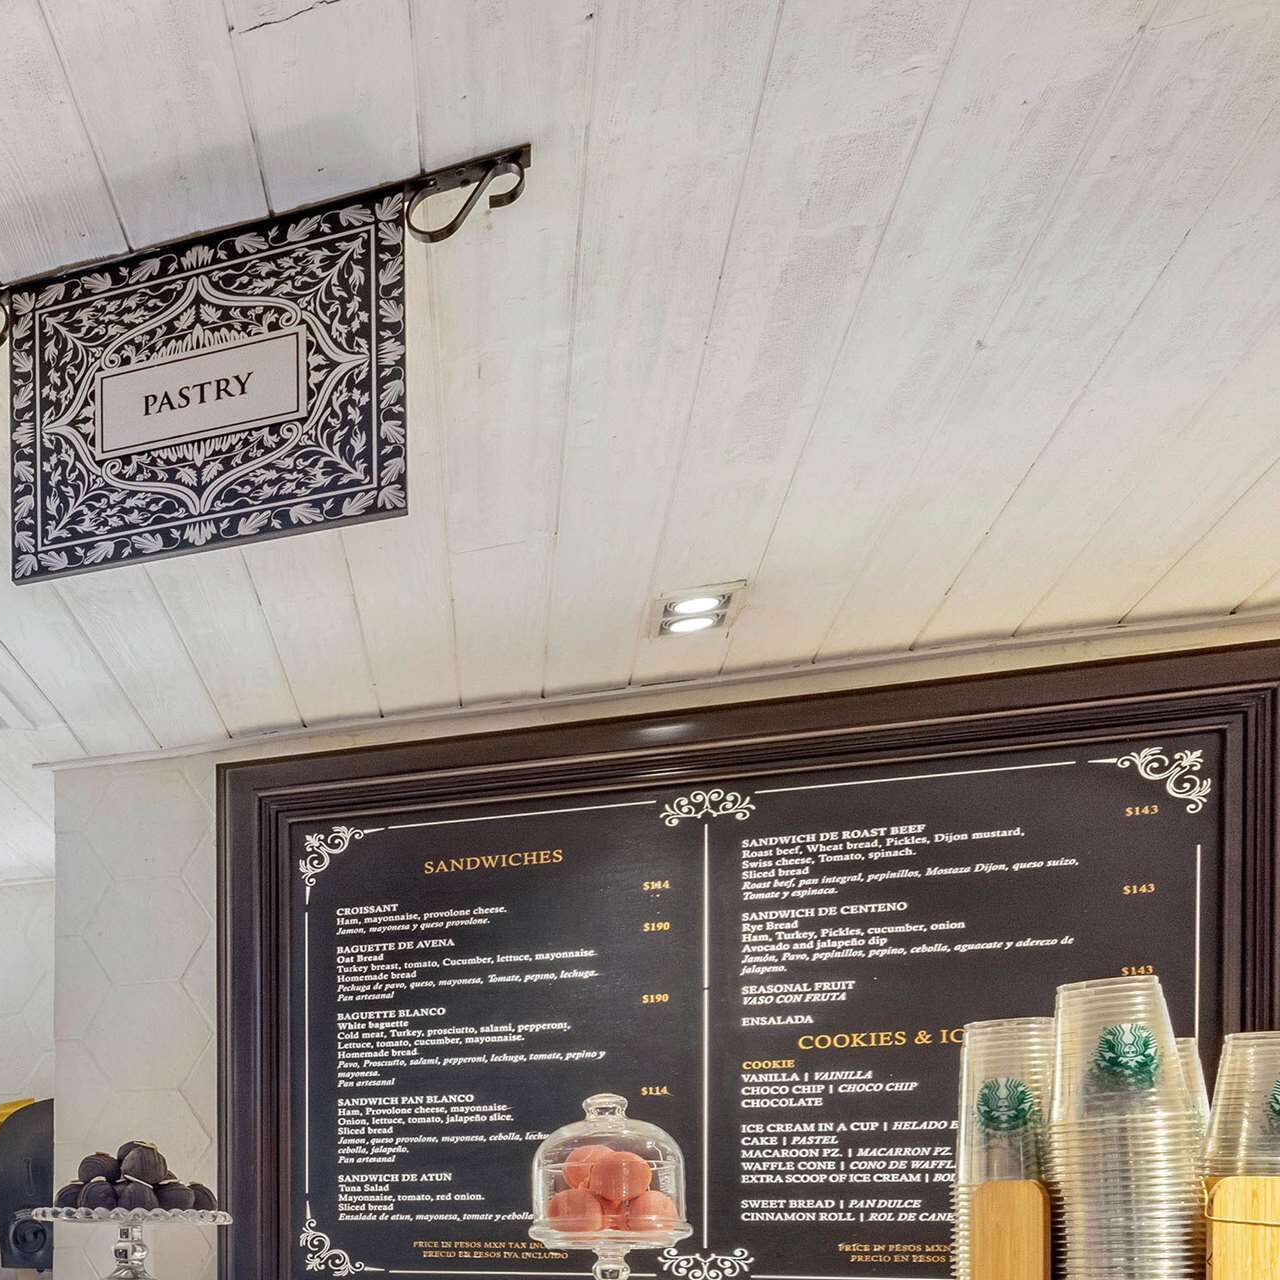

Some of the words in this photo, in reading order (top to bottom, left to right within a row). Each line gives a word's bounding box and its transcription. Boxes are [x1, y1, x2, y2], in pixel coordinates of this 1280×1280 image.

[144, 371, 254, 416] PASTRY
[1125, 805, 1159, 817] $143
[742, 833, 816, 848] SANDWICH
[819, 832, 839, 841] DE
[842, 827, 887, 839] ROAST
[890, 824, 926, 835] BEEF
[742, 849, 773, 859] Roast
[806, 843, 843, 853] Wheat
[934, 833, 968, 843] Dijon
[425, 849, 563, 873] SANDWICHES
[742, 869, 776, 880] Sliced
[778, 866, 810, 877] bread
[1123, 883, 1155, 895] $143
[336, 904, 398, 916] CROISSANT
[423, 909, 471, 920] provolone
[742, 908, 815, 921] SANDWICH
[818, 906, 838, 916] DE
[840, 902, 908, 915] CENTENO
[643, 922, 670, 932] $190
[742, 923, 763, 933] Rye
[766, 920, 799, 930] Bread
[337, 942, 396, 954] BAGUETTE
[398, 941, 414, 950] DE
[416, 938, 455, 948] AVENA
[741, 942, 790, 954] Avocado
[792, 940, 814, 950] and
[868, 936, 888, 946] dip
[336, 956, 354, 964] Oat
[357, 953, 384, 962] Bread
[336, 965, 368, 973] Turkey
[741, 983, 812, 995] SEASONAL
[814, 980, 856, 991] FRUIT
[642, 994, 669, 1004] $190
[743, 995, 774, 1005] VASO
[775, 994, 803, 1004] CON
[804, 992, 846, 1002] FRUTA
[337, 1010, 396, 1021] BAGUETTE
[398, 1007, 446, 1018] BLANCO
[337, 1022, 366, 1030] White
[368, 1020, 409, 1030] baguette
[741, 1015, 814, 1027] ENSALADA
[337, 1031, 359, 1040] Cold
[798, 1031, 906, 1049] COOKIES
[914, 1030, 932, 1044] &
[337, 1048, 389, 1059] Homemade
[391, 1048, 419, 1056] bread
[742, 1060, 795, 1070] COOKIE
[741, 1072, 800, 1083] VANILLA
[814, 1070, 872, 1081] VAINILLA
[741, 1085, 790, 1095] CHOCO
[792, 1084, 825, 1094] CHIP
[838, 1083, 884, 1093] CHOCO
[885, 1082, 918, 1091] CHIP
[337, 1097, 398, 1107] SANDWICH
[401, 1096, 424, 1104] PAN
[426, 1094, 474, 1104] BLANCO
[741, 1097, 823, 1108] CHOCOLATE
[365, 1107, 412, 1115] Provolone
[338, 1127, 365, 1135] Sliced
[367, 1126, 393, 1134] bread
[741, 1124, 765, 1133] ICE
[766, 1123, 815, 1133] CREAM
[818, 1122, 834, 1132] IN
[836, 1123, 848, 1132] A
[850, 1122, 879, 1131] CUP
[741, 1136, 778, 1146] CAKE
[791, 1135, 839, 1145] PASTEL
[741, 1148, 820, 1158] MACAROON
[822, 1148, 843, 1157] PZ.
[856, 1147, 932, 1157] MACARRON
[932, 1147, 953, 1156] PZ.
[741, 1161, 795, 1171] WAFFLE
[797, 1161, 836, 1170] CONE
[849, 1161, 887, 1170] CONO
[888, 1160, 908, 1169] DE
[338, 1174, 399, 1185] SANDWICH
[401, 1173, 418, 1182] DE
[420, 1173, 452, 1181] ATUN
[741, 1174, 784, 1183] EXTRA
[785, 1174, 828, 1183] SCOOP
[828, 1174, 848, 1183] OF
[848, 1173, 871, 1182] ICE
[873, 1173, 921, 1182] CREAM
[338, 1184, 362, 1192] Tuna
[364, 1184, 389, 1192] Salad
[741, 1199, 787, 1208] SWEET
[789, 1199, 835, 1208] BREAD
[741, 1212, 816, 1221] CINNAMON
[819, 1212, 855, 1221] ROLL
[867, 1213, 895, 1221] ROL
[897, 1213, 917, 1221] DE
